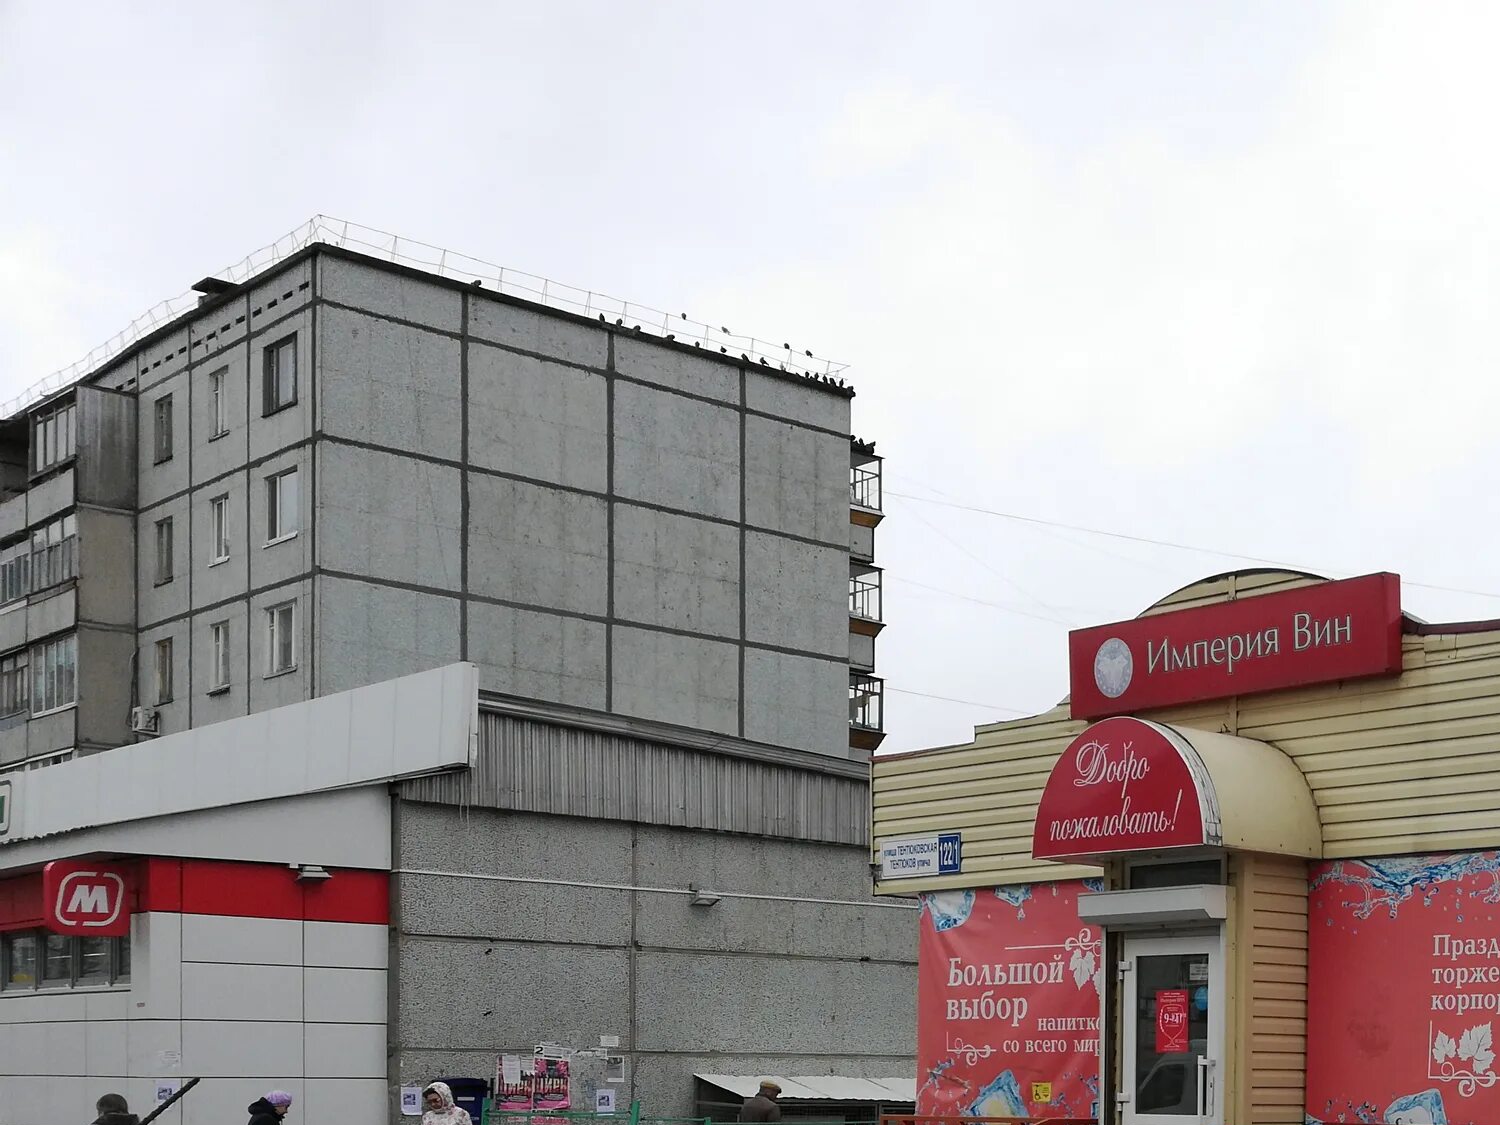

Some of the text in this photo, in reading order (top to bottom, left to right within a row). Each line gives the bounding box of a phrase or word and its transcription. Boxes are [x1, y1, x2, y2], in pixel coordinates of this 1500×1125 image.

[1147, 612, 1351, 675] Империя Вин
[1073, 740, 1151, 799] Добро
[1049, 788, 1183, 841] пожаловать!
[940, 840, 958, 866] 122/1
[947, 953, 1065, 987] Большой
[946, 990, 1028, 1027] выбор
[1002, 1039, 1020, 1053] со
[1025, 1039, 1067, 1053] всего
